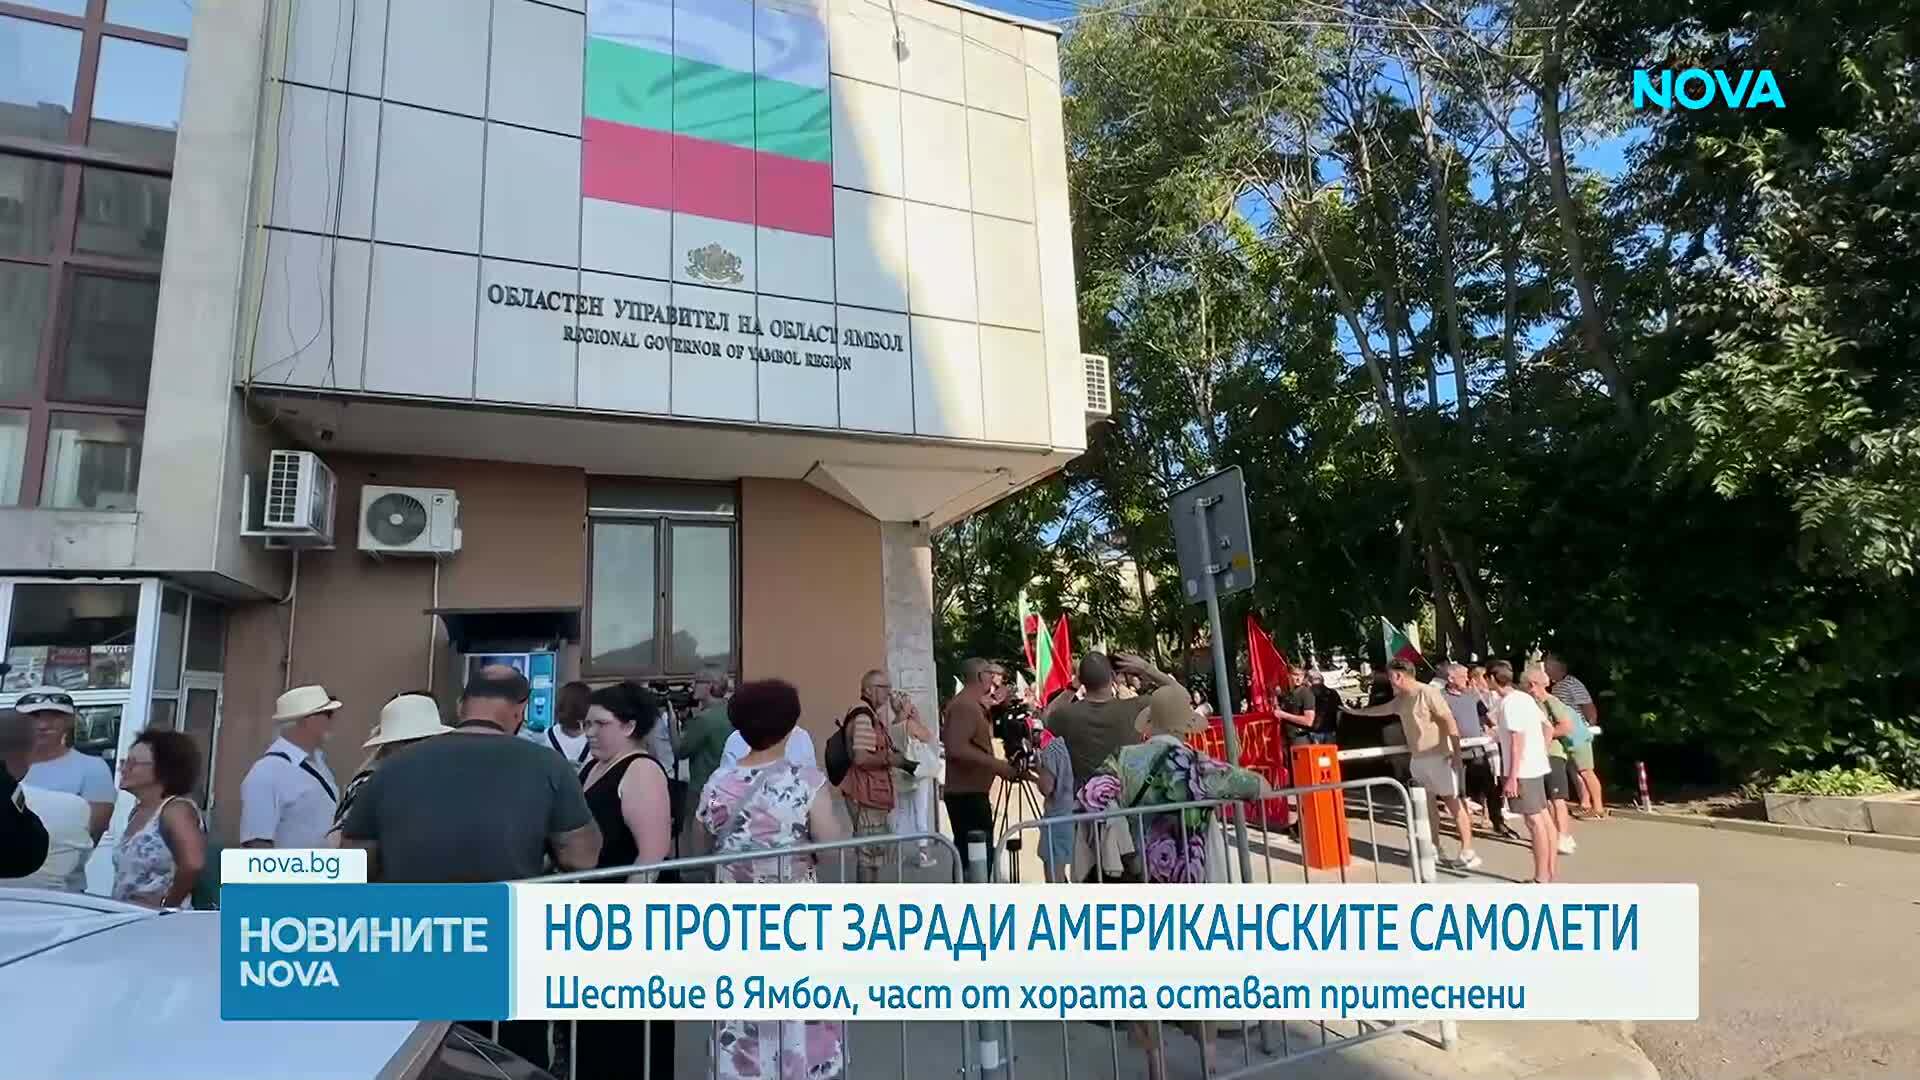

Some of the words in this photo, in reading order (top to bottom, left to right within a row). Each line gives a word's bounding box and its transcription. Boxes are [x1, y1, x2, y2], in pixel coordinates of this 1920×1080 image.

[487, 284, 605, 316] ОБЛАСТЕН
[614, 298, 730, 331] УПРАВИТЕЛ
[738, 314, 764, 335] НА
[770, 320, 839, 344] ОБЛАСТ
[843, 328, 904, 352] ЯМБОЛ
[563, 325, 640, 348] REGIONAL
[644, 334, 722, 357] GOVERNOR
[726, 344, 745, 359] OF
[748, 345, 801, 366] YAMBOL
[805, 352, 852, 371] REGION
